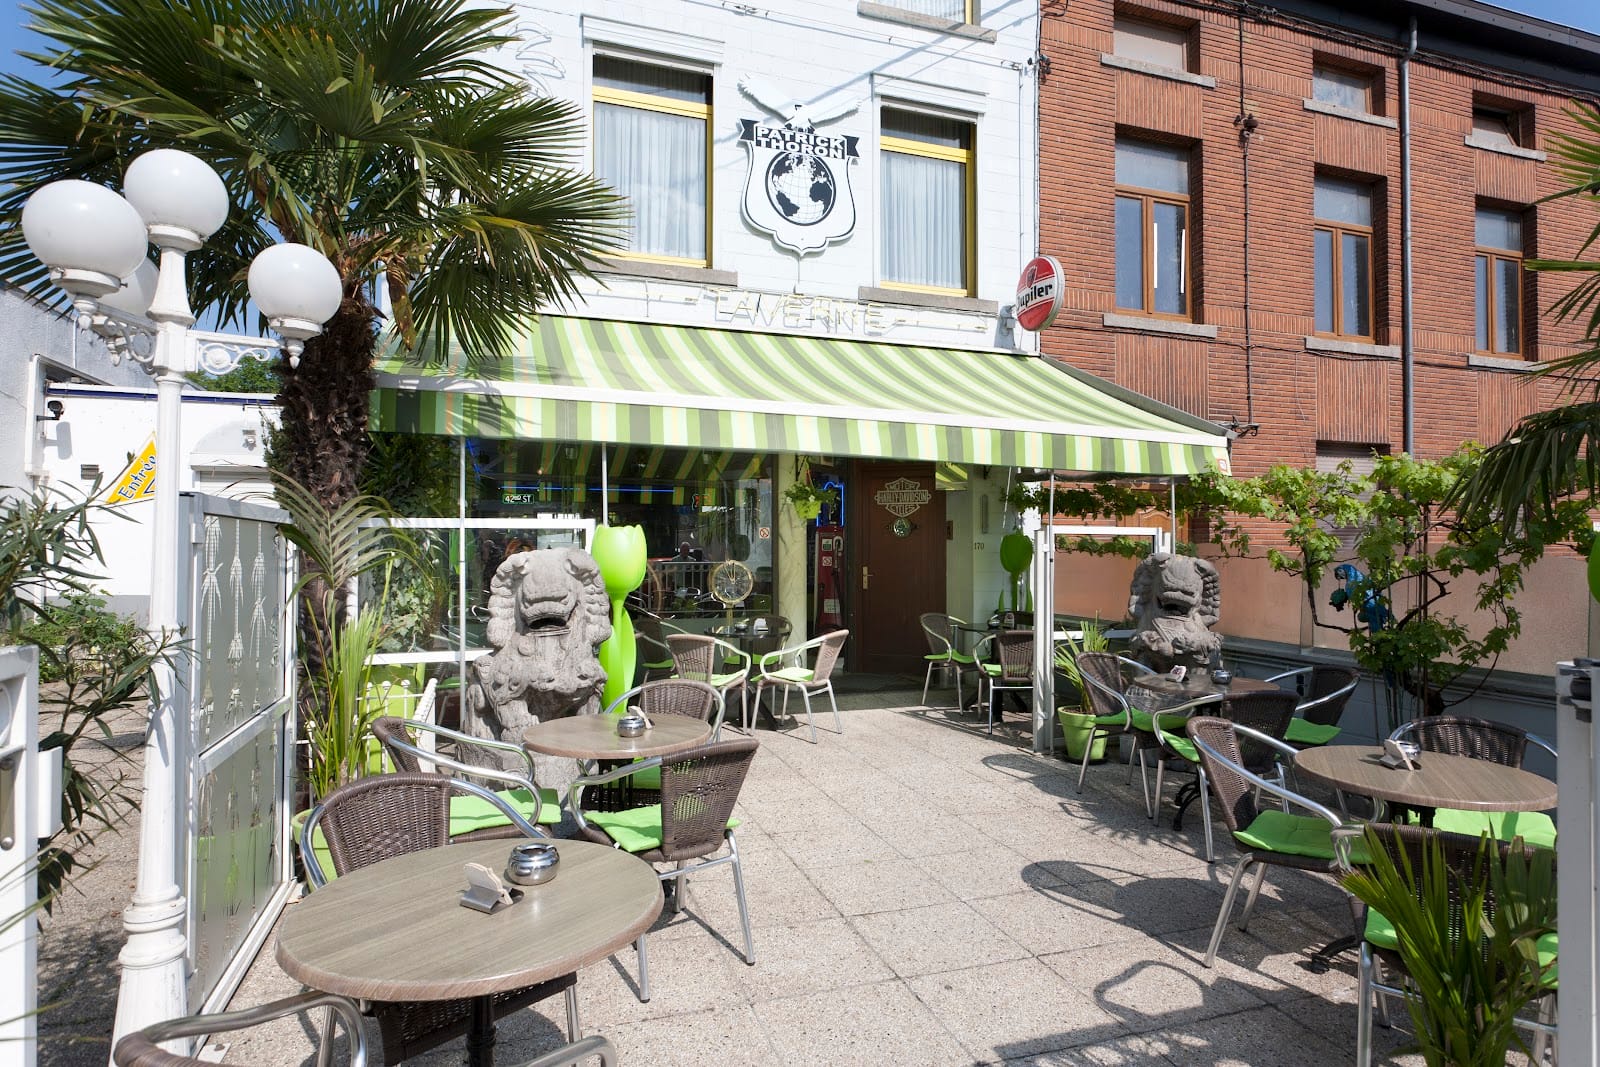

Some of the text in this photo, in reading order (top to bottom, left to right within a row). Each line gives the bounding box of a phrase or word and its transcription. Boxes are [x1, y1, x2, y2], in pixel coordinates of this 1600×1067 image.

[756, 127, 843, 149] PATRICK
[757, 137, 843, 158] THORON
[1017, 284, 1053, 311] Jupiler
[522, 495, 531, 503] ST
[974, 542, 985, 550] 170
